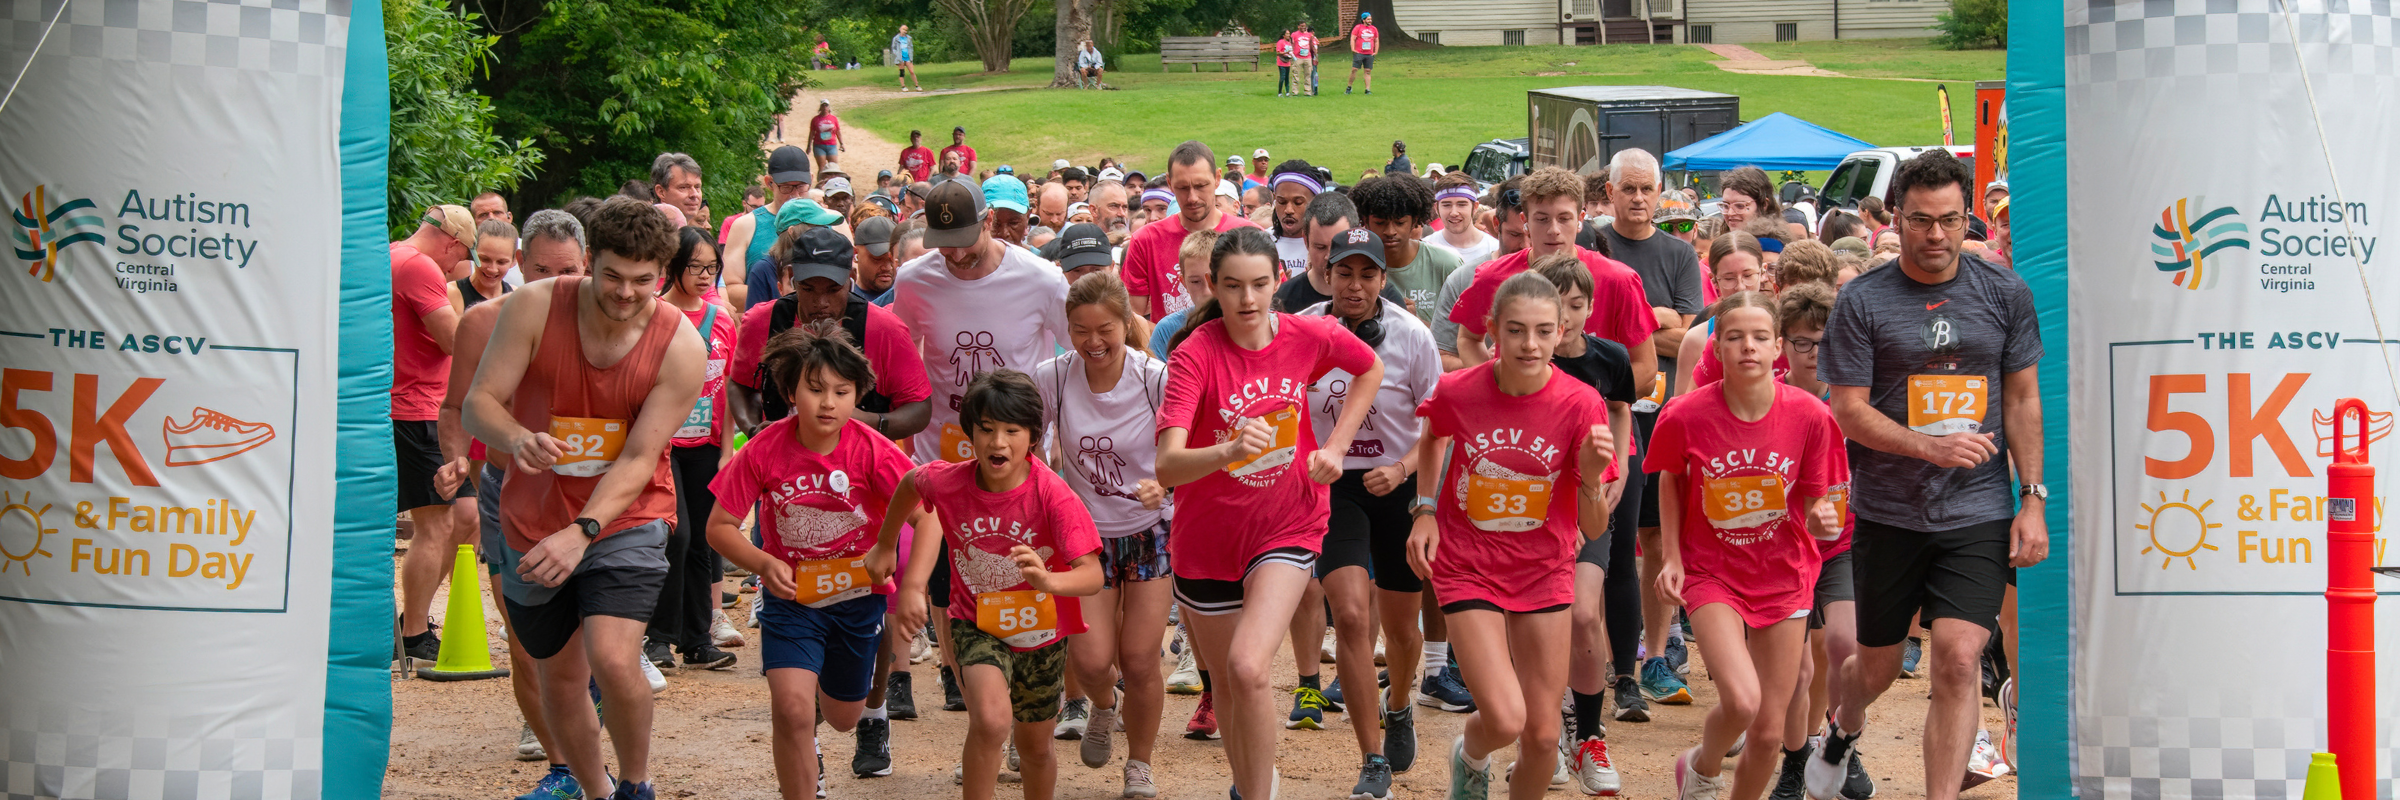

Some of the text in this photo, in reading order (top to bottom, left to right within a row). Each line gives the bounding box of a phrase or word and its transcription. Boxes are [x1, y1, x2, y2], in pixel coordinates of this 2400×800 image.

[117, 188, 250, 228] Autism
[2260, 194, 2368, 225] Autism
[115, 224, 258, 268] Society
[2260, 227, 2376, 264] Society
[115, 261, 174, 276] Central
[2260, 263, 2312, 275] Central
[115, 276, 178, 293] Virginia
[1409, 289, 1427, 301] 5K
[2260, 278, 2315, 293] Virginia
[49, 328, 206, 356] THE ASCV
[1932, 321, 1951, 349] B
[2198, 331, 2340, 350] THE ASCV
[1218, 377, 1305, 424] ASCV 5K
[1922, 391, 1975, 415] 172
[0, 367, 167, 488] 5K
[686, 408, 711, 424] 51
[2144, 372, 2315, 480] 5K
[566, 433, 604, 457] 82
[1356, 444, 1379, 454] Trot
[1464, 428, 1560, 463] ASCV 5K
[1701, 448, 1794, 477] ASCV 5K
[770, 473, 825, 505] ASCV
[1238, 475, 1271, 488] FAMILY
[1487, 493, 1527, 514] 33
[1724, 489, 1765, 512] 38
[2269, 488, 2386, 532] Fay
[1008, 520, 1038, 544] 5K
[1724, 536, 1756, 546] FAMILY
[1758, 530, 1774, 542] FUN
[2238, 530, 2312, 564] Fun
[70, 537, 254, 590] Fun Day
[816, 571, 852, 595] 59
[998, 606, 1039, 631] 58
